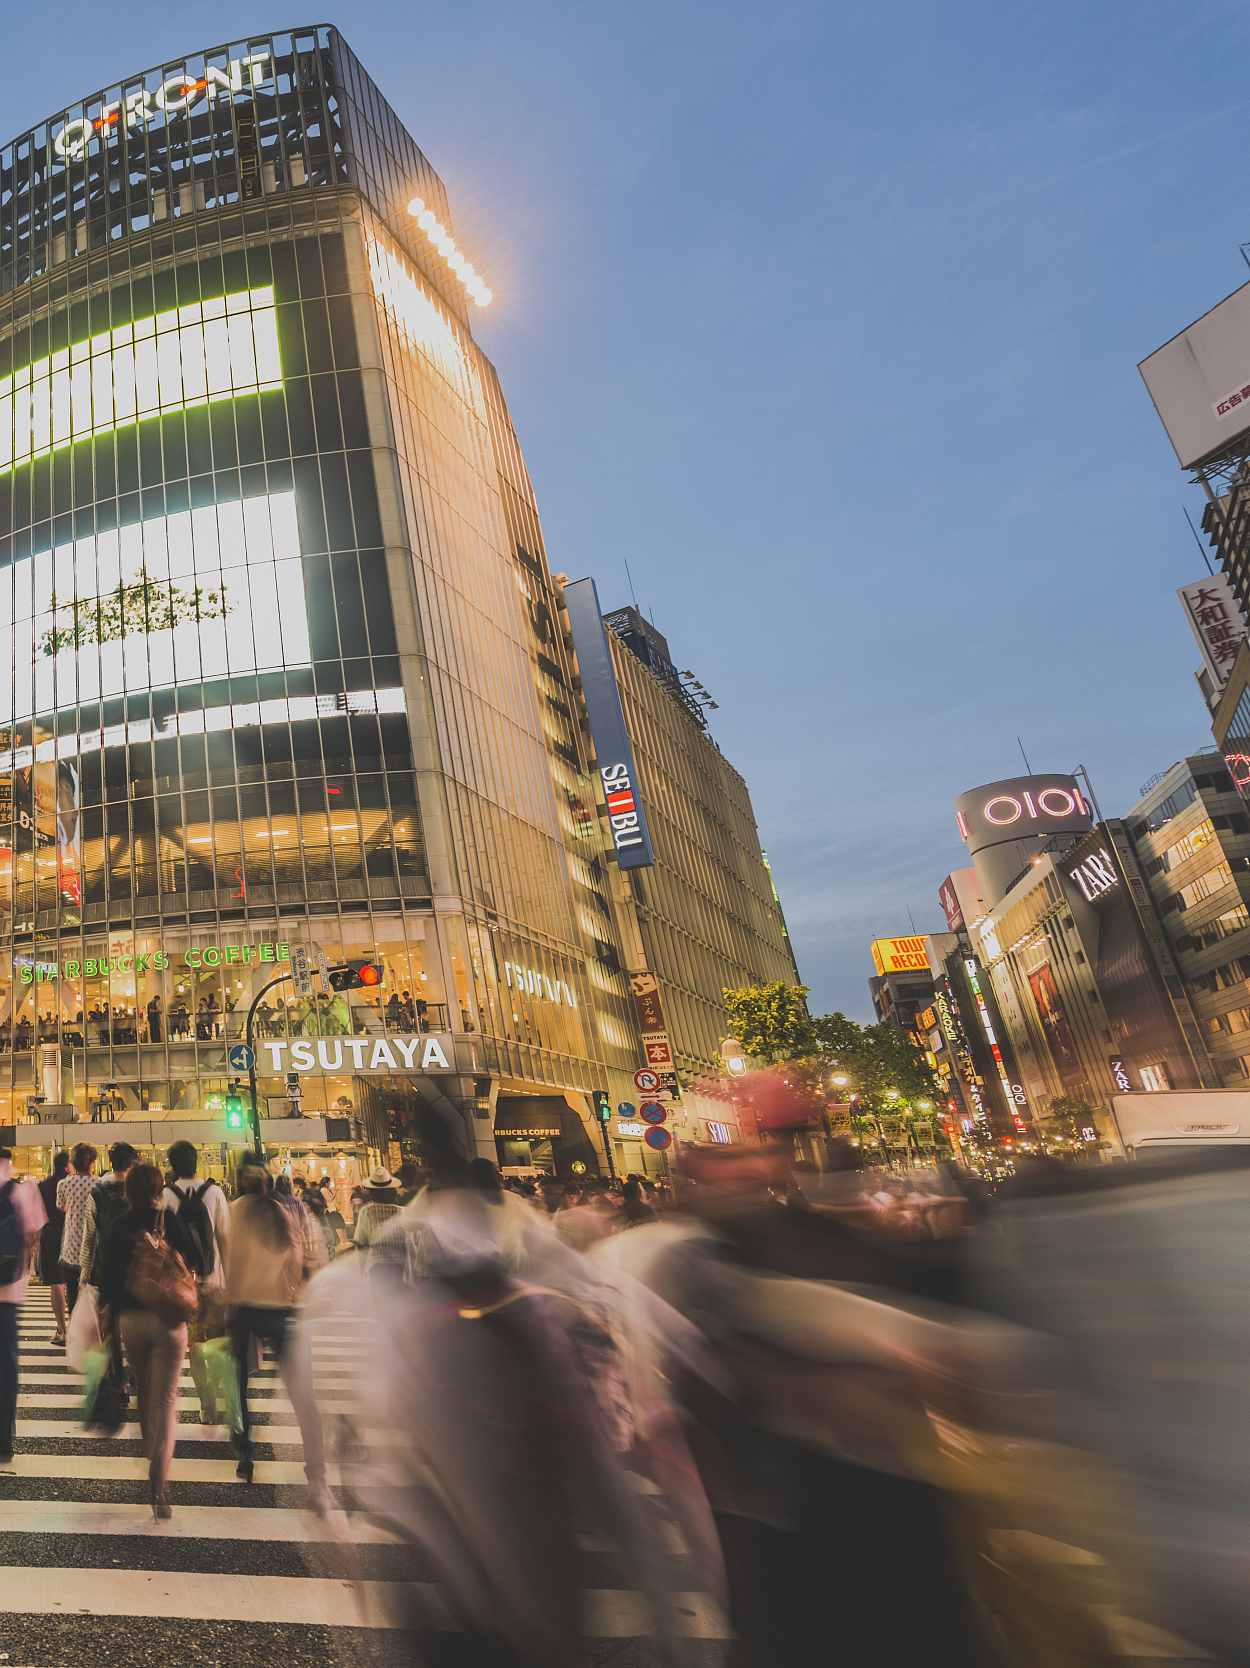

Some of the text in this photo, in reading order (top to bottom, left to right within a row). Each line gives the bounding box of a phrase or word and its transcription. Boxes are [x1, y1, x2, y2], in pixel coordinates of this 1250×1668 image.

[1190, 588, 1241, 683] 大和証券
[601, 763, 643, 850] SEIBU
[20, 942, 291, 985] STARBUCKS COFFEE
[934, 991, 958, 1041] KARAOKE
[262, 1038, 451, 1072] TSUTAYA
[650, 1045, 668, 1061] 本
[1111, 1061, 1130, 1092] ZAR
[528, 1128, 561, 1136] COFFEE
